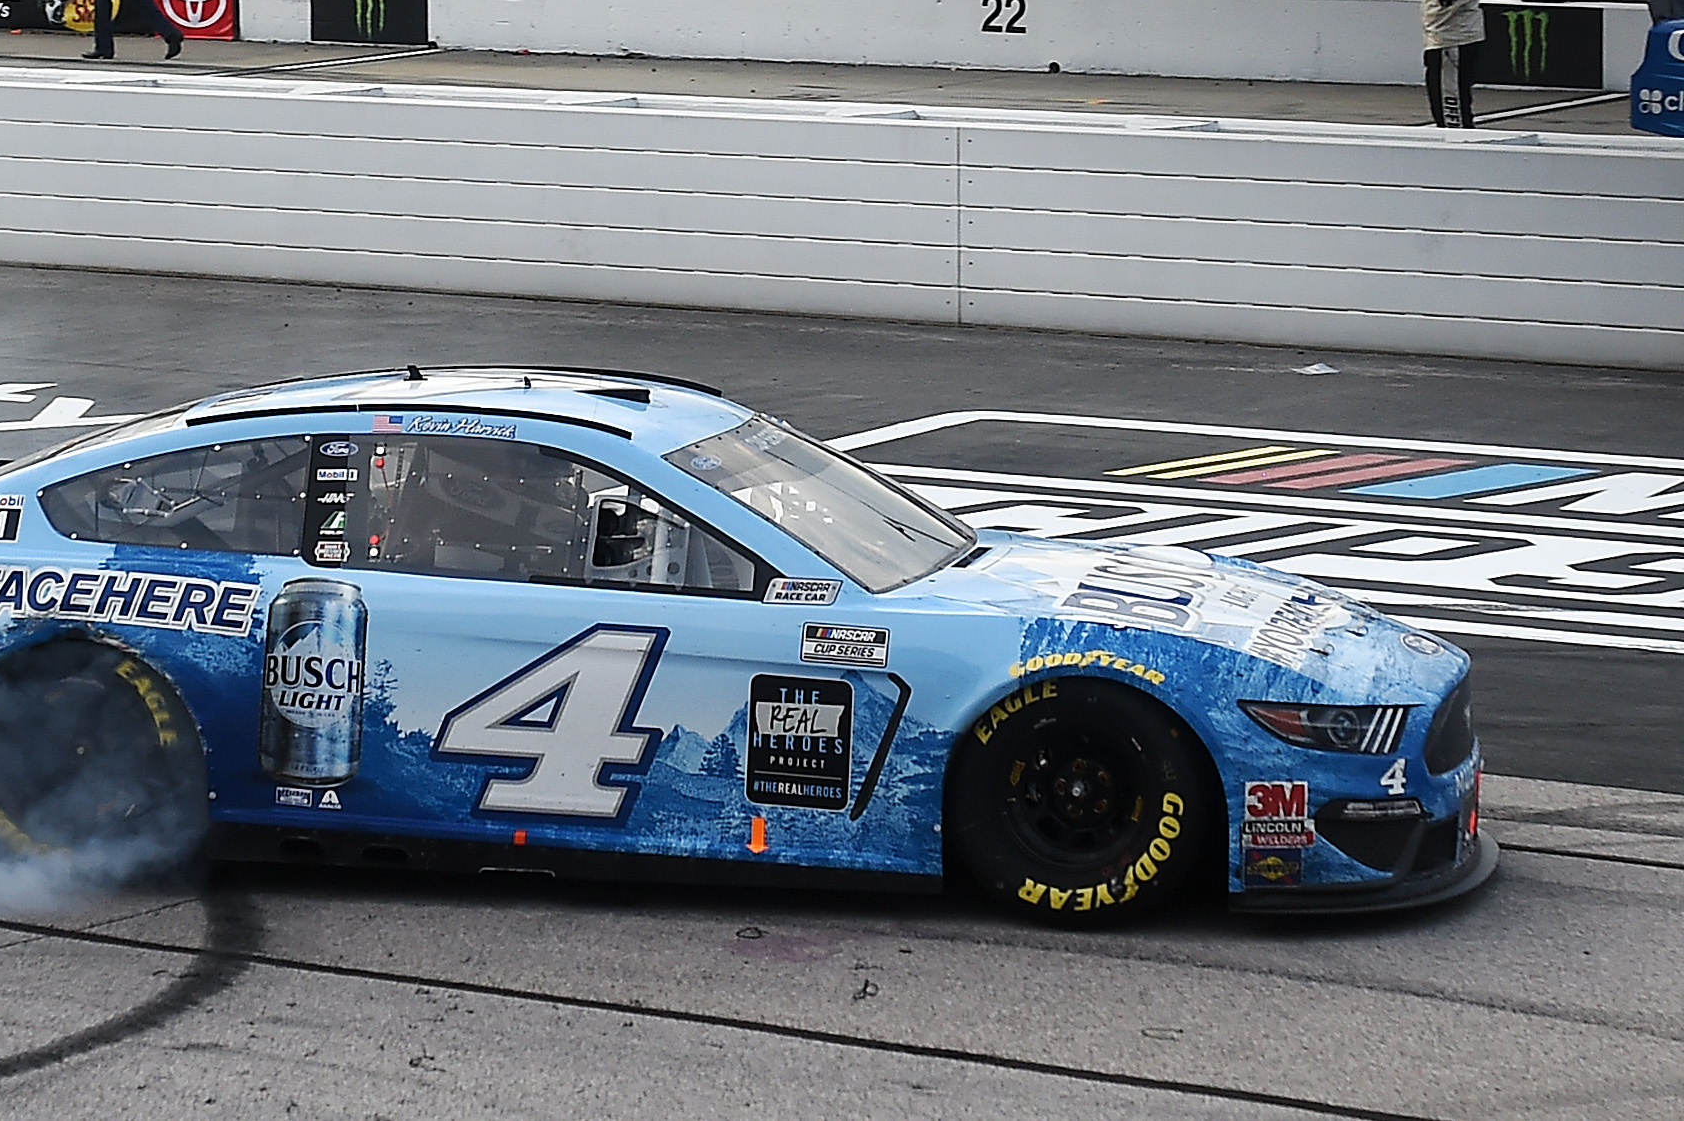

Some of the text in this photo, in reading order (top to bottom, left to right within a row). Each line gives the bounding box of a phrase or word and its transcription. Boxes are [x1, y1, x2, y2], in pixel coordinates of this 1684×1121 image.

[72, 5, 97, 23] Sho
[407, 415, 516, 439] Kevin Harvick
[318, 471, 345, 479] Mobil
[774, 592, 826, 601] RACE CAR
[790, 581, 831, 592] NASCAR
[830, 629, 877, 642] NASCAR
[814, 643, 876, 658] CUP SERIES
[265, 654, 361, 694] BUSCH
[1009, 649, 1166, 685] GOODYEAR
[116, 660, 177, 747] EAGLE
[278, 691, 346, 711] LIGHT
[779, 687, 820, 705] THE
[770, 705, 827, 734] REAL
[973, 680, 1058, 745] EAGLE
[433, 625, 668, 823] 4
[753, 732, 843, 754] HEROES
[769, 755, 825, 769] PROJECT
[1379, 758, 1407, 796] 4
[753, 780, 843, 799] #THEREALHEROES
[1246, 783, 1306, 818] 3M
[1245, 821, 1302, 834] LINCOLN
[1256, 835, 1309, 846] WELDERS
[1017, 792, 1185, 911] GOODYEAR
